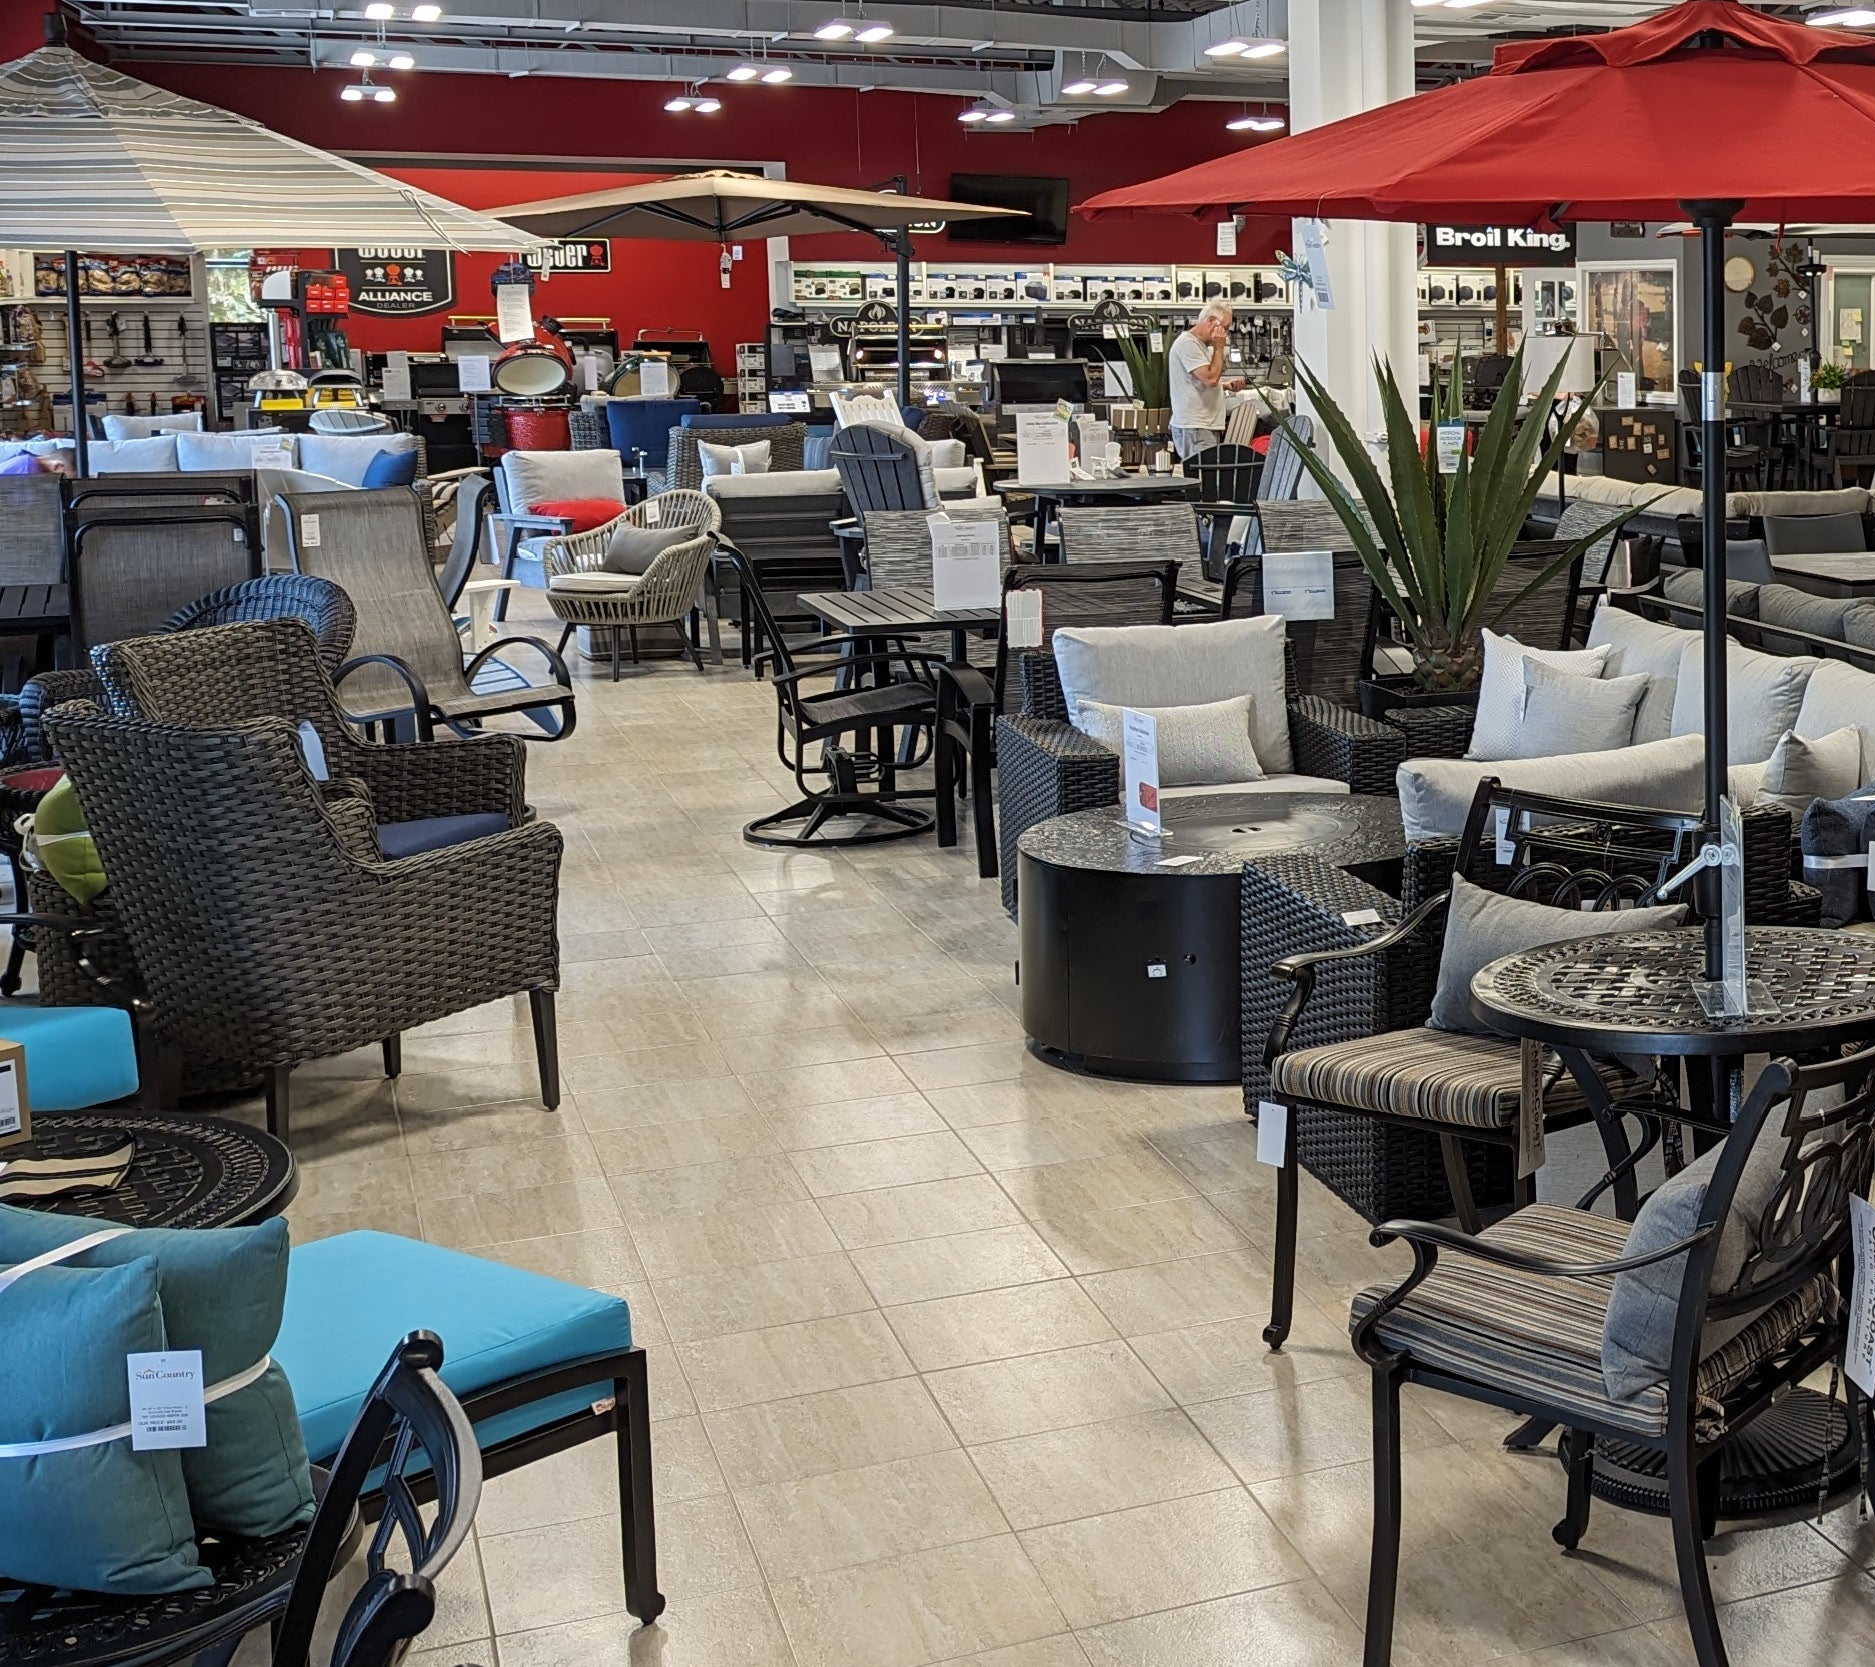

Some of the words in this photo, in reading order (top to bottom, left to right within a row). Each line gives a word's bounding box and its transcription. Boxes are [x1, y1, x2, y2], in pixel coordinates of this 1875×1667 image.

[1435, 226, 1501, 247] Broil
[358, 291, 433, 302] ALLIANCE
[837, 320, 918, 333] NAPOLEN
